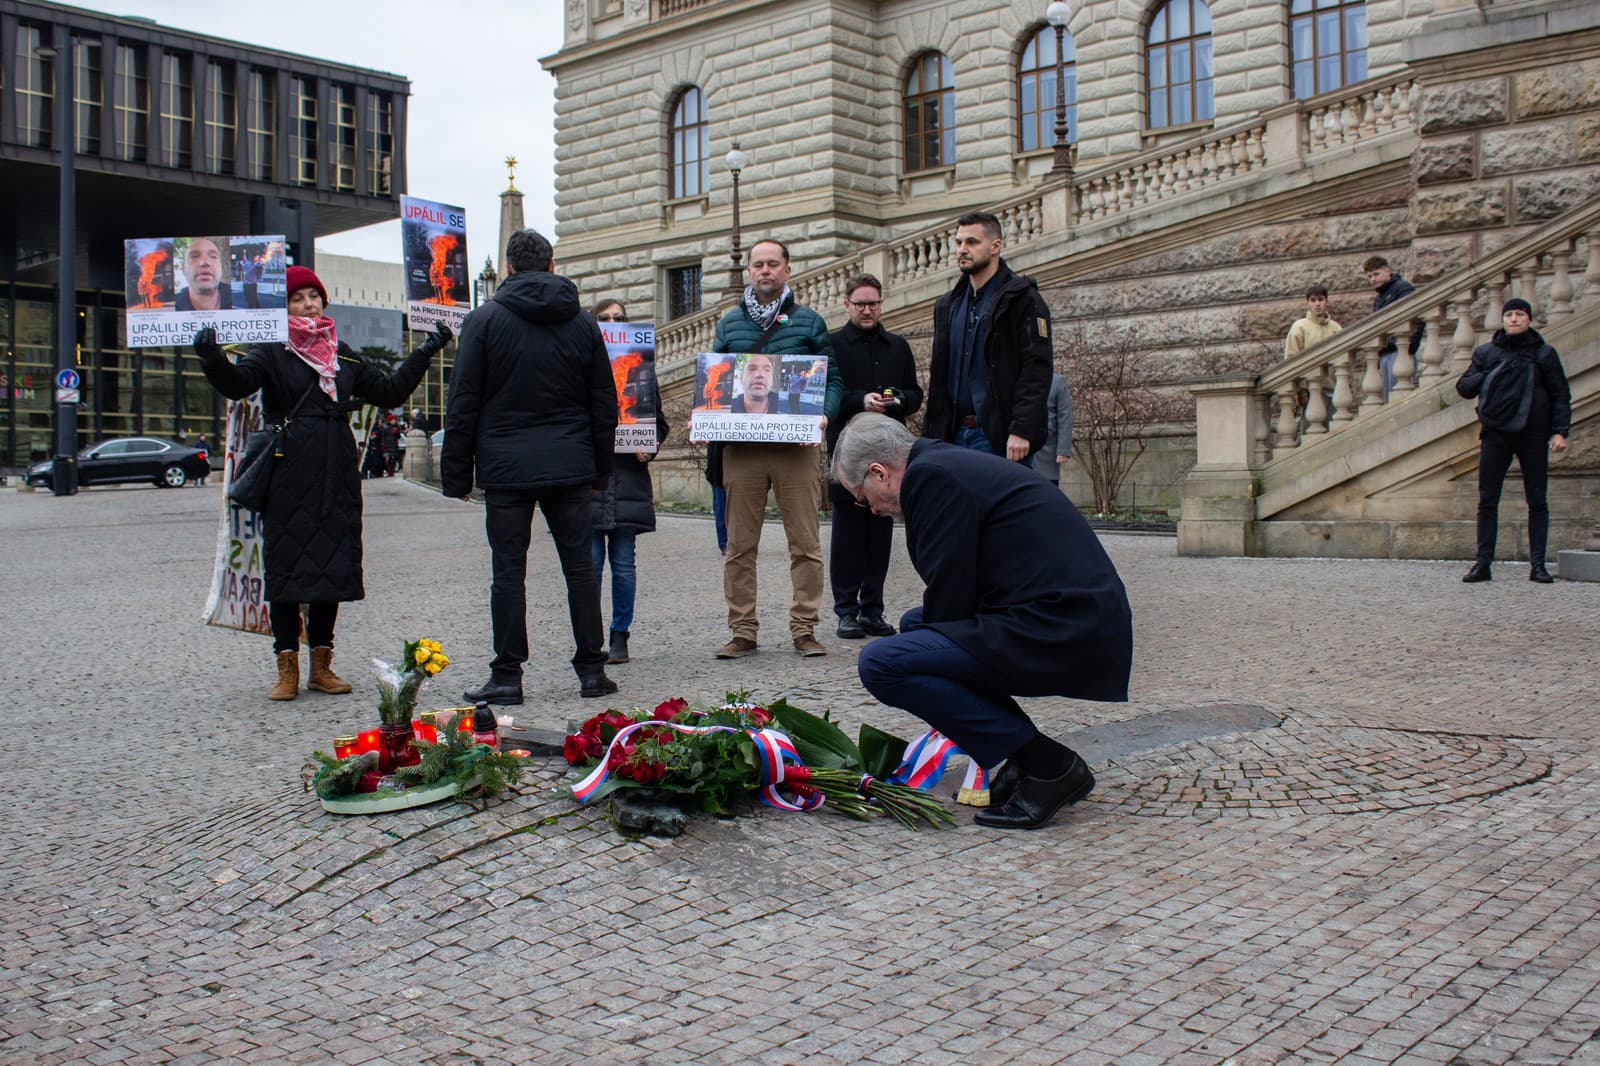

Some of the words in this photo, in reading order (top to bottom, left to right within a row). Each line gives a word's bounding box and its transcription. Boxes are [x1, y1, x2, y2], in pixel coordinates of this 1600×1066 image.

[404, 204, 447, 225] UPÁLIL
[449, 214, 464, 228] SE
[410, 305, 421, 313] NA
[422, 306, 450, 317] PROTEST
[452, 311, 465, 320] PRO
[132, 322, 178, 335] UPÁLILI
[182, 322, 198, 332] SE
[201, 321, 218, 331] NA
[221, 319, 279, 330] PROTEST
[133, 335, 168, 345] PROTI
[171, 331, 232, 345] GENDĚ
[235, 332, 244, 342] V
[246, 331, 278, 342] GAZE
[602, 328, 631, 344] ÁLIL
[634, 331, 653, 344] SE
[695, 421, 732, 431] UPÁLILI
[734, 422, 748, 431] SE
[750, 423, 766, 431] NA
[767, 423, 815, 433] PROTEST
[632, 439, 654, 447] GAZE
[693, 431, 722, 440] PROTI
[724, 430, 775, 441] GENOCIDĚ
[777, 432, 785, 441] V
[786, 432, 813, 442] GAZE
